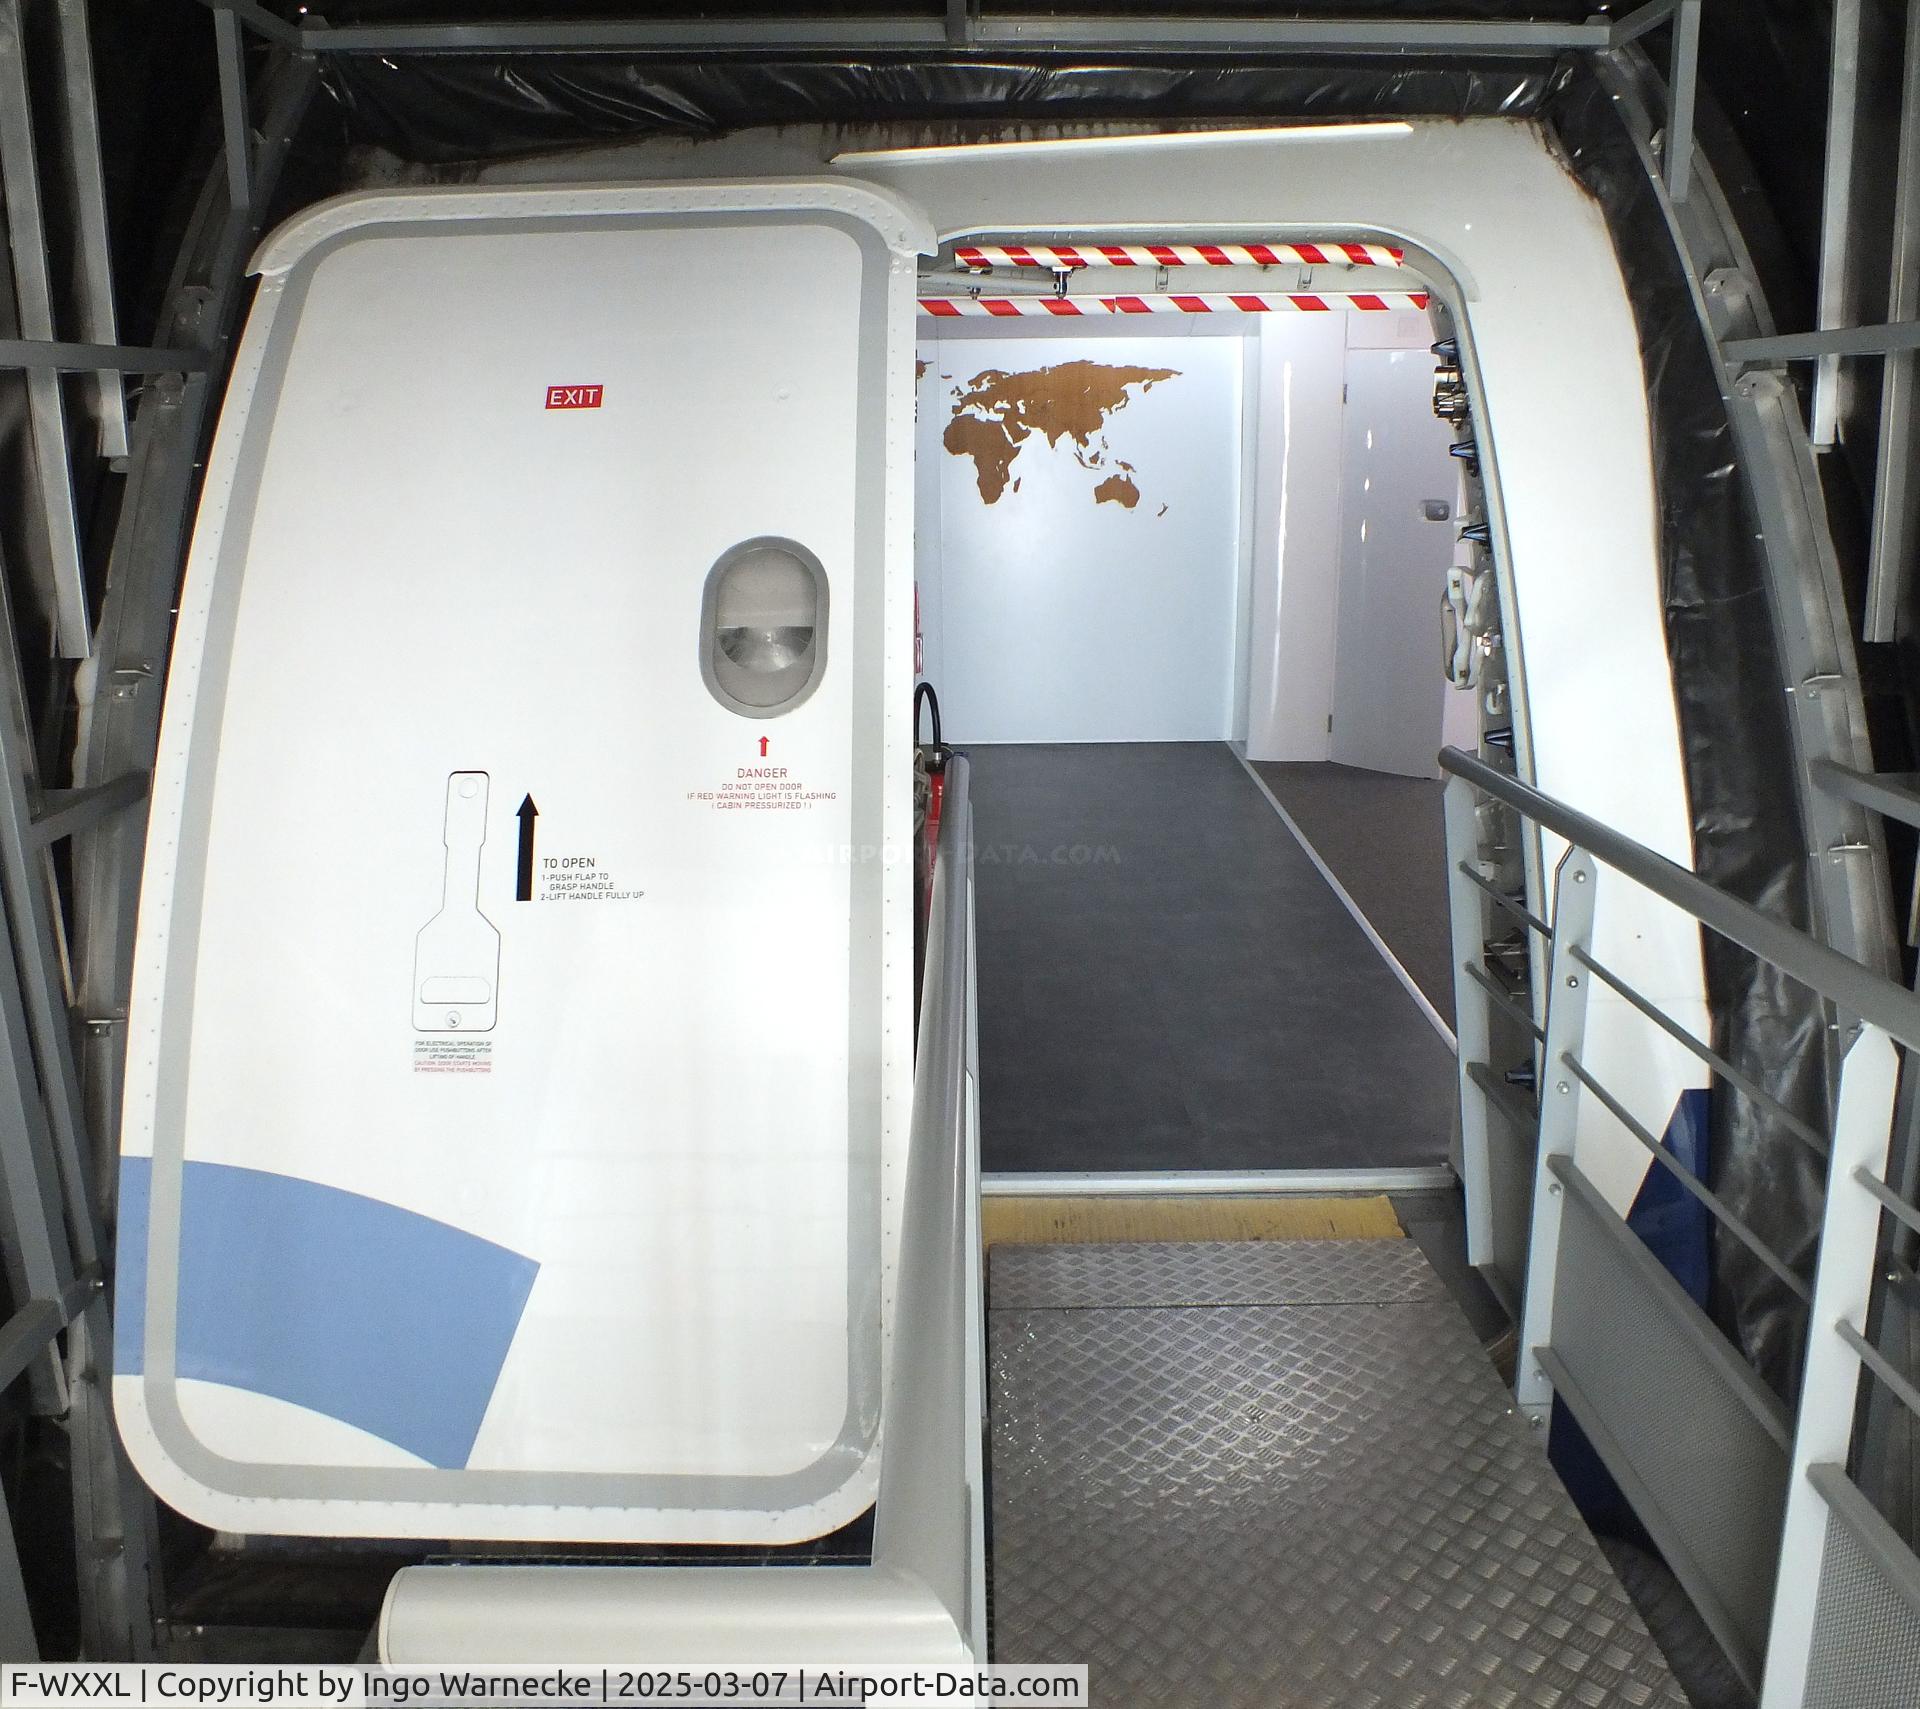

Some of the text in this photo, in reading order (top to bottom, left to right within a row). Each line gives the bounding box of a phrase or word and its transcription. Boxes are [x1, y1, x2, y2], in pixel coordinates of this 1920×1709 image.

[550, 389, 598, 405] EXIT
[738, 768, 788, 778] DANGER
[544, 858, 595, 868] TO OPEN
